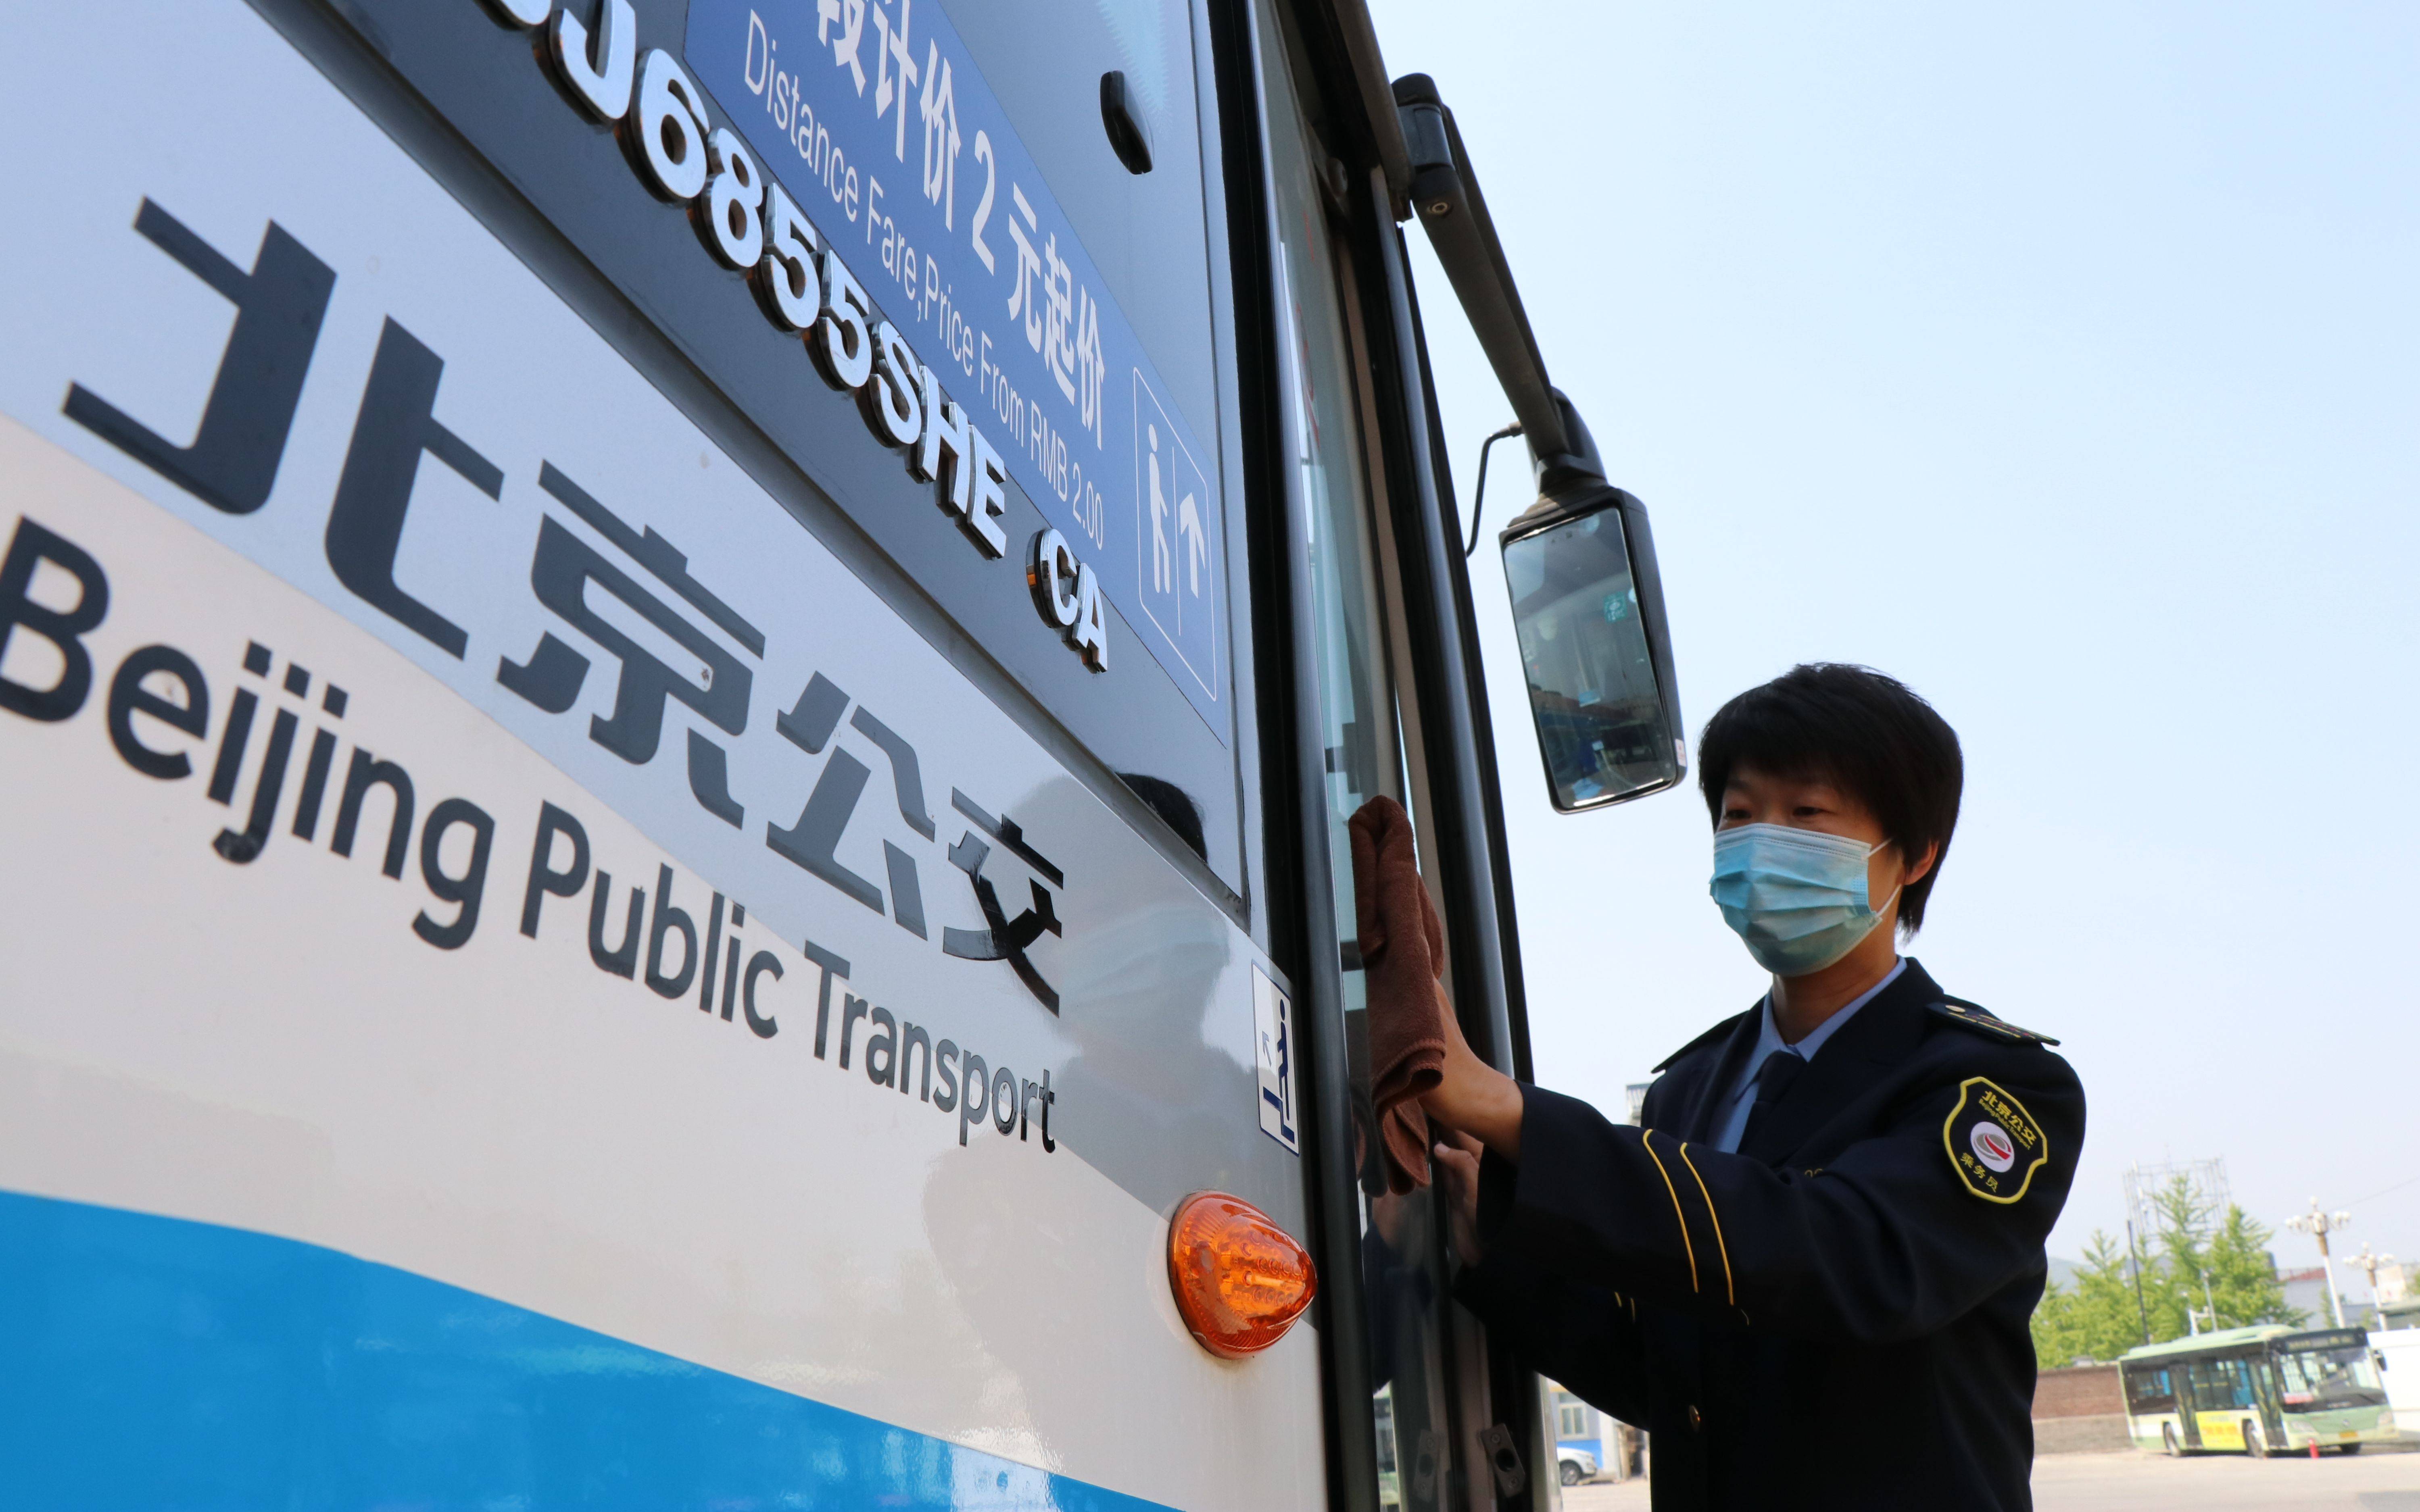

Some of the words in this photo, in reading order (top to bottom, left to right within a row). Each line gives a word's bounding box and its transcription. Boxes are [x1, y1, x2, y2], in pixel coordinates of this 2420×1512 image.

[482, 0, 1007, 560] J6855SHE
[1037, 528, 1108, 673] CA
[745, 8, 859, 222] Distance
[867, 175, 973, 377] Fare,Price
[981, 330, 1024, 448] From
[1031, 399, 1068, 502] RMB
[1072, 462, 1103, 550] 2.00
[0, 514, 496, 951] Beijing
[520, 799, 784, 1039] Public
[805, 940, 1056, 1154] Transport
[61, 195, 1064, 1018] 北京公交
[1960, 1152, 1999, 1193] 乘务员
[1982, 1091, 2036, 1145] 北京公交
